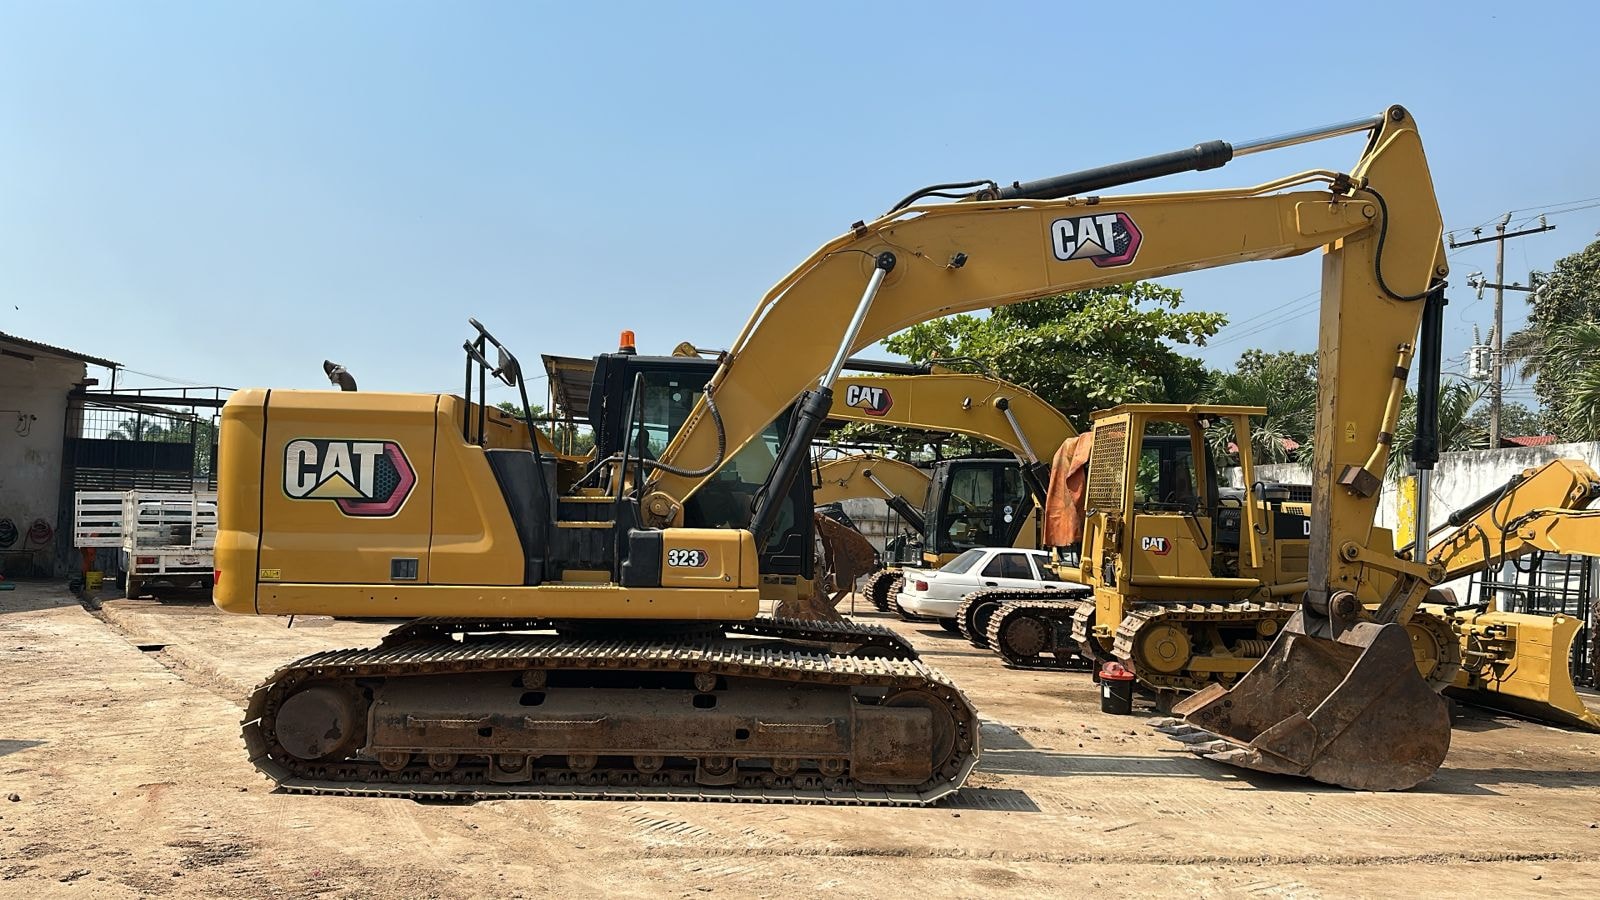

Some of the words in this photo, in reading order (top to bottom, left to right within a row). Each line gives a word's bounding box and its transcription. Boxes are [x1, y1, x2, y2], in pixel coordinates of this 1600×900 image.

[1052, 214, 1117, 260] CAT
[847, 385, 883, 410] CAT
[285, 440, 384, 498] CAT
[1142, 537, 1165, 551] CAT
[668, 550, 699, 566] 323
